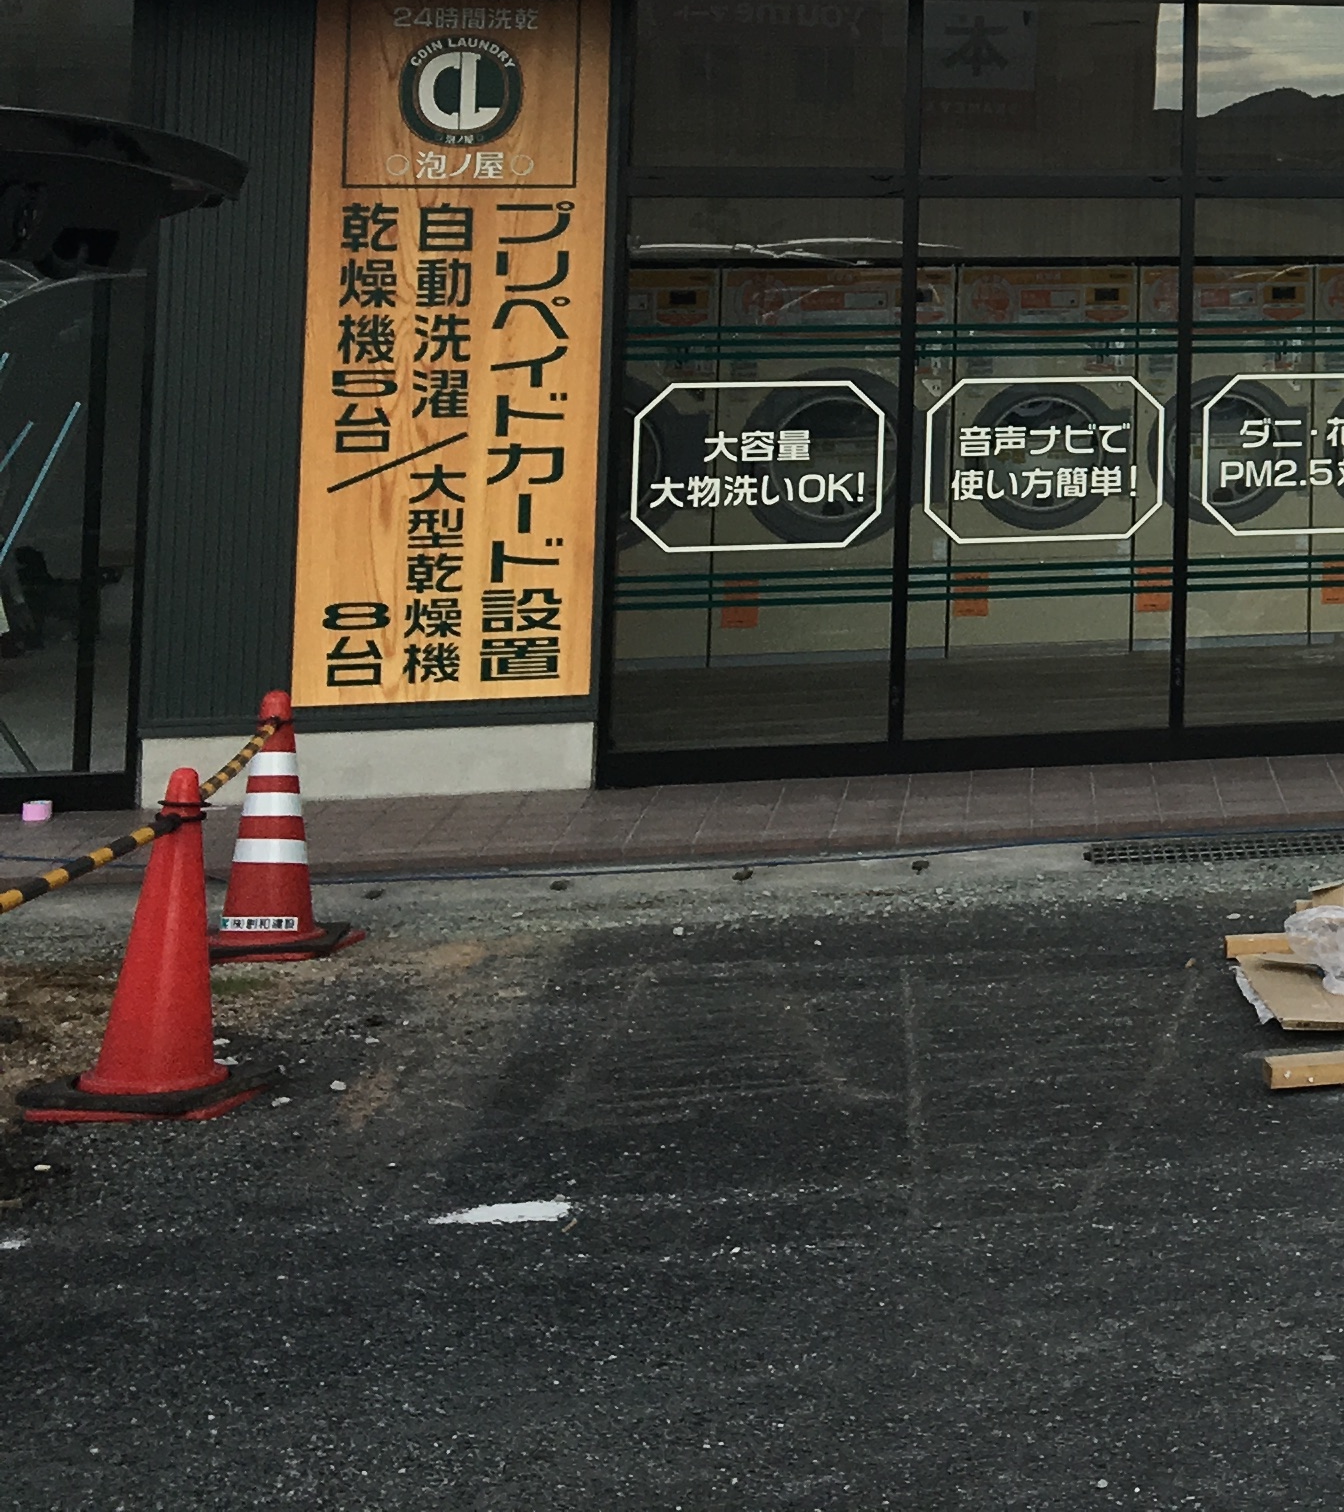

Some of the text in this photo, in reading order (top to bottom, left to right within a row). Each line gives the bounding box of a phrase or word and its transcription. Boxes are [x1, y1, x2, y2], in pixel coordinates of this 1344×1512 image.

[392, 5, 540, 32] 24時間洗乾
[409, 36, 517, 70] COIN LAUNDRY
[414, 150, 506, 181] 泡ノ屋
[331, 201, 400, 455] 乾燥機5台
[411, 201, 474, 420] 自動洗濯
[478, 200, 576, 683] プリペイドカード設置
[703, 429, 811, 463] 大容量
[958, 422, 1131, 457] 音声ナビで
[649, 471, 865, 509] 大物洗いOK!
[951, 465, 1138, 501] 使い方簡単！
[402, 462, 468, 684] 大型乾燥機
[321, 600, 392, 687] 8台
